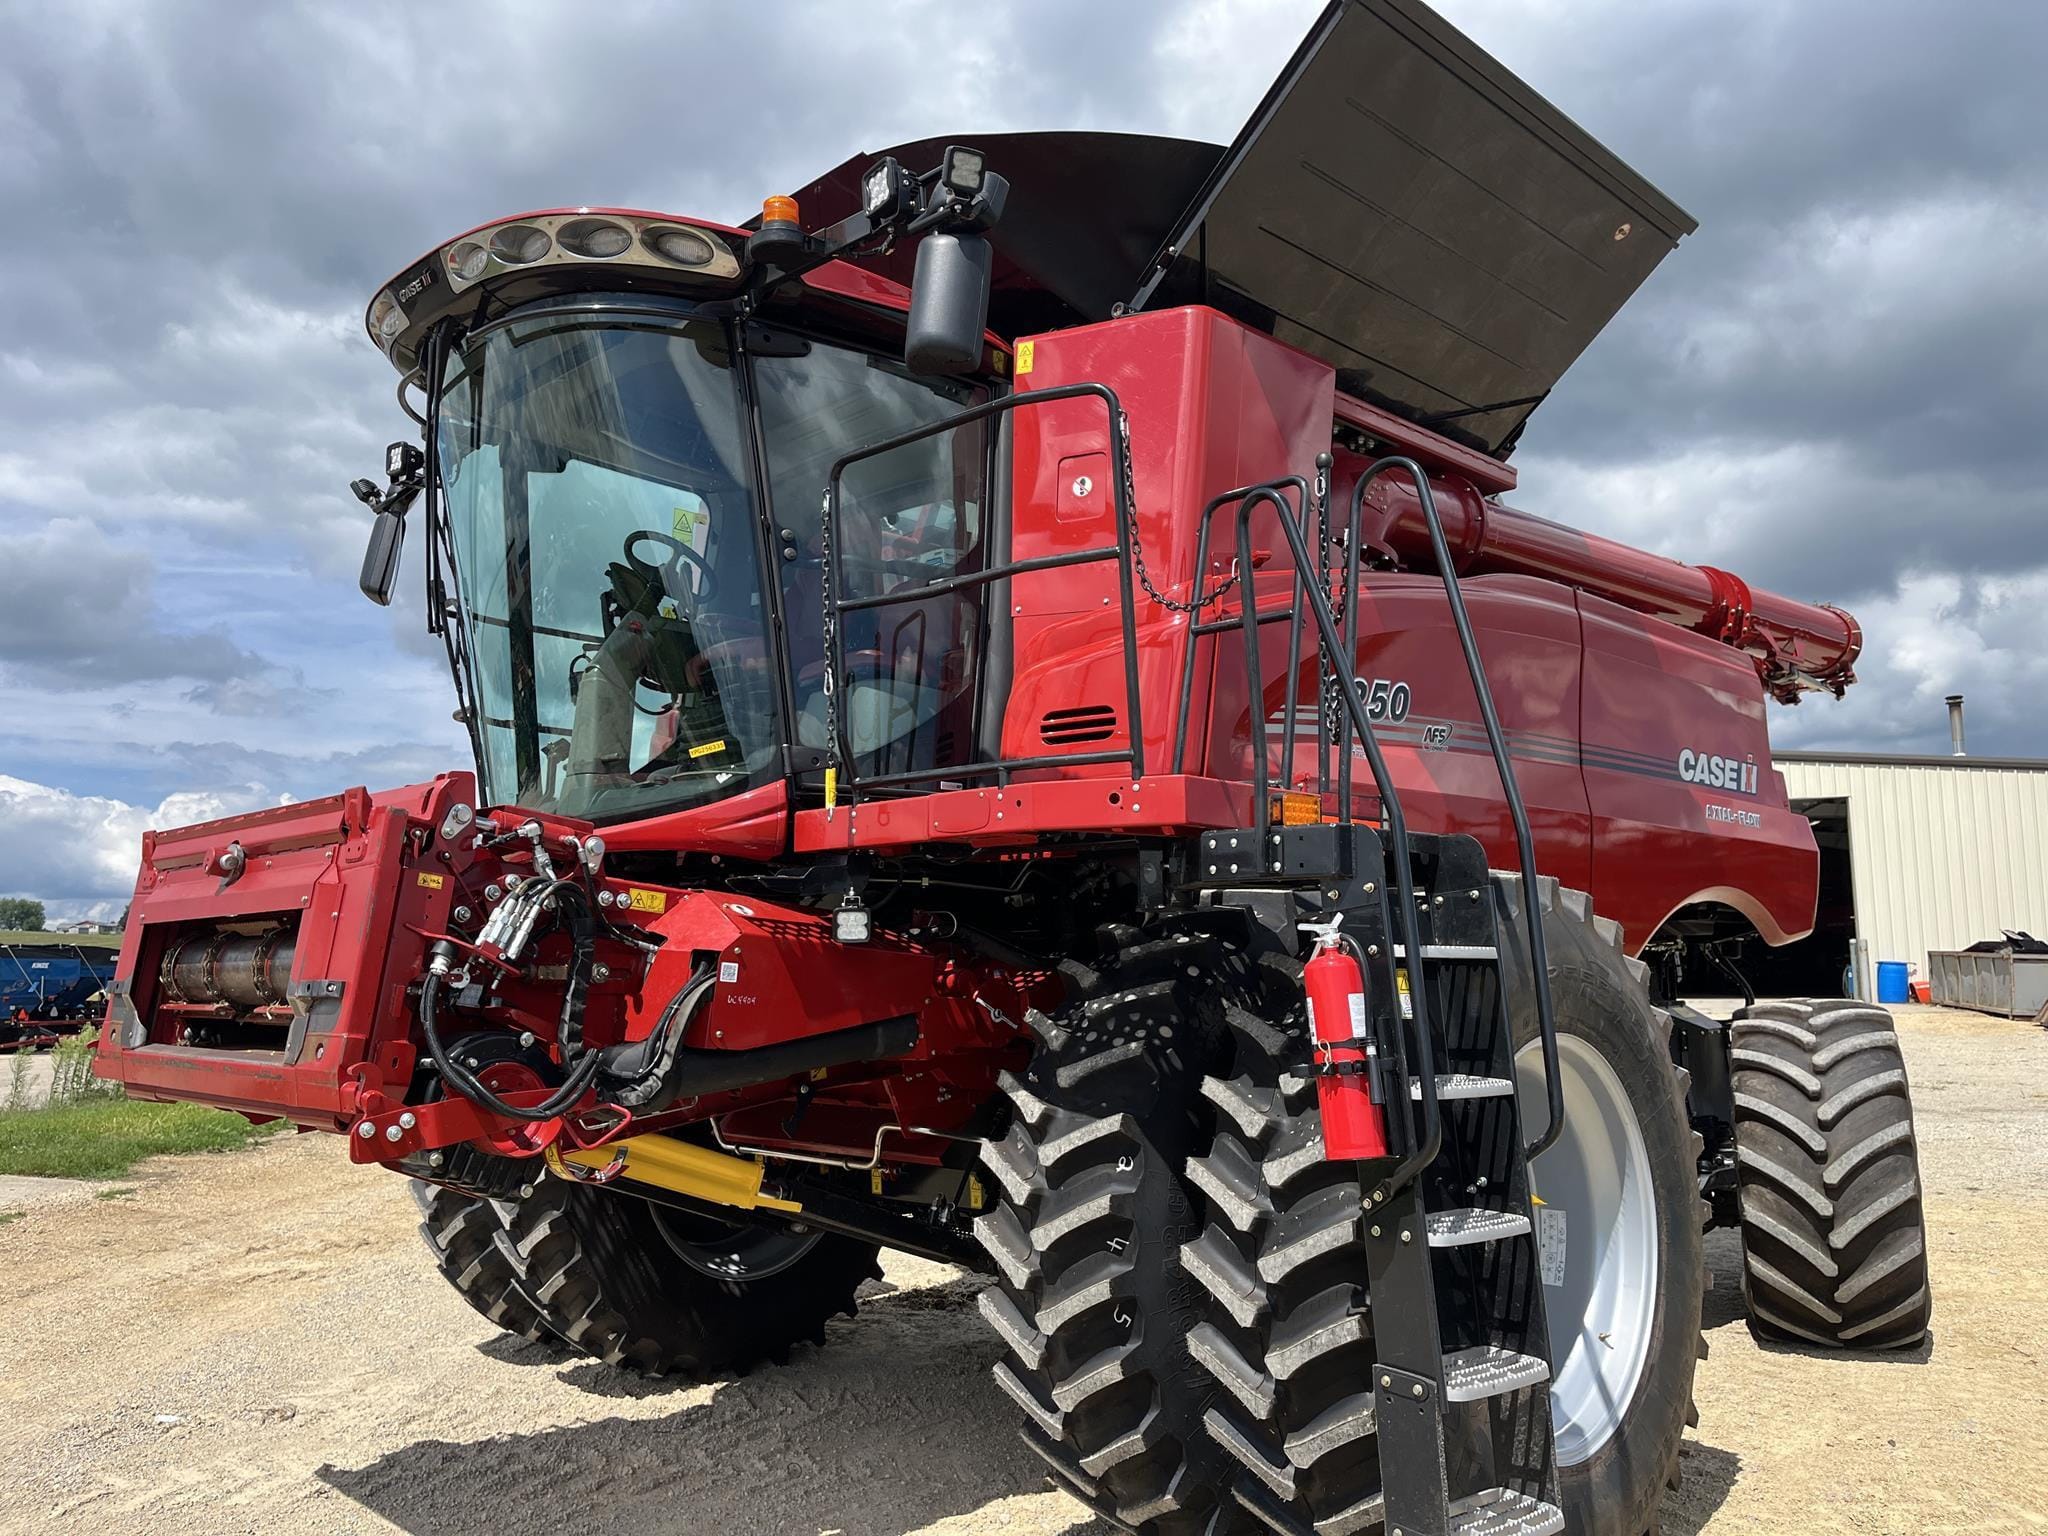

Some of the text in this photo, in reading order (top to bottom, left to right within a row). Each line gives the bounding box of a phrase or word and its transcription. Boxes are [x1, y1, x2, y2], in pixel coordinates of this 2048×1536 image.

[399, 278, 423, 303] CASE
[1422, 725, 1447, 744] AFS
[1679, 748, 1738, 790] CASE
[1705, 804, 1760, 829] AXIAL-FLOW
[1106, 1236, 1130, 1252] 4
[1113, 1303, 1132, 1329] 5
